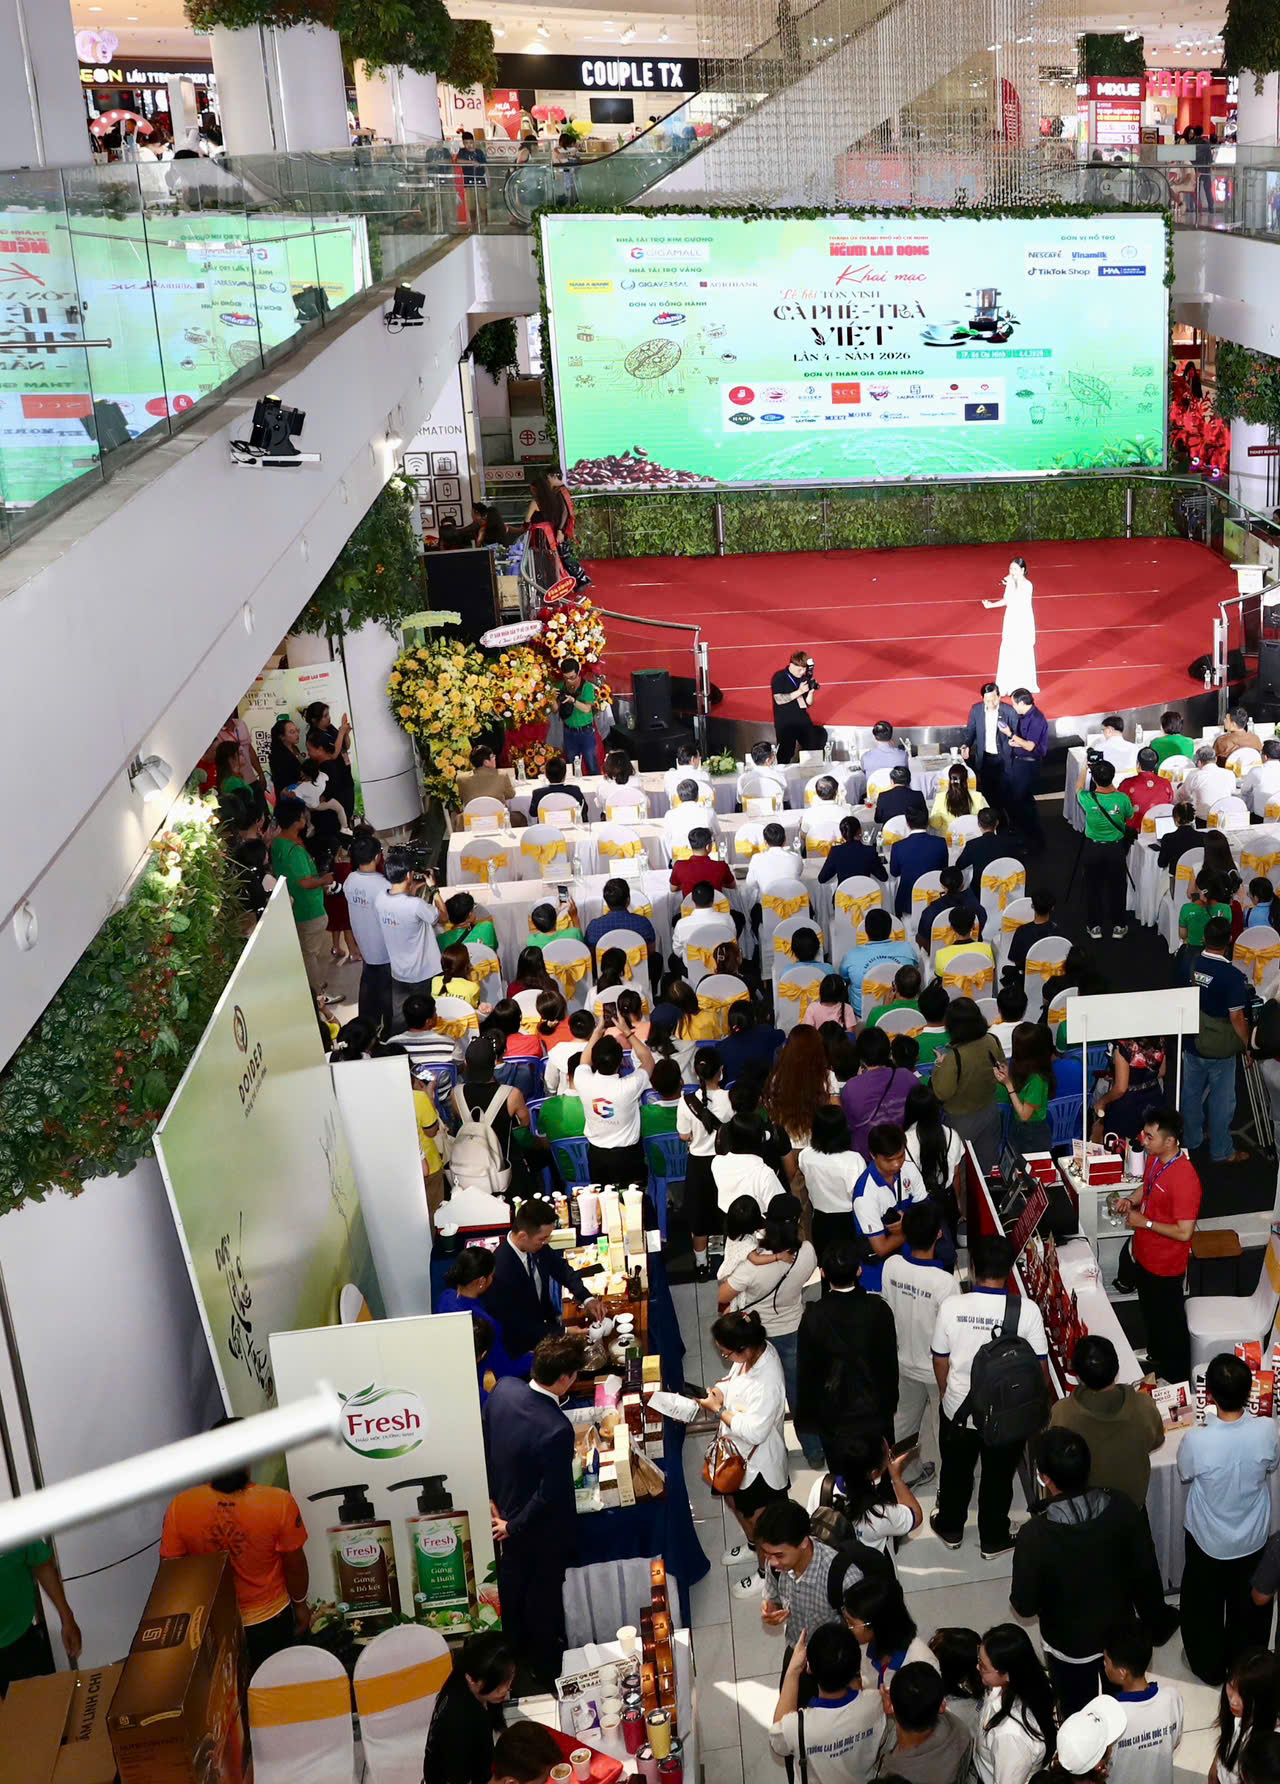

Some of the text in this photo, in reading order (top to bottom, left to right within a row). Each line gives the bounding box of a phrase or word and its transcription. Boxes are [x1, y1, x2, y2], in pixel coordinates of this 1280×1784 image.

[581, 60, 684, 88] COUPLE TX
[1097, 83, 1141, 96] MIXUE
[835, 264, 888, 286] Khai
[879, 351, 911, 360] 2026
[346, 1408, 422, 1436] Fresh
[423, 1533, 455, 1548] Fresh
[345, 1544, 378, 1558] Fresh
[83, 1671, 102, 1719] CHI LINH
